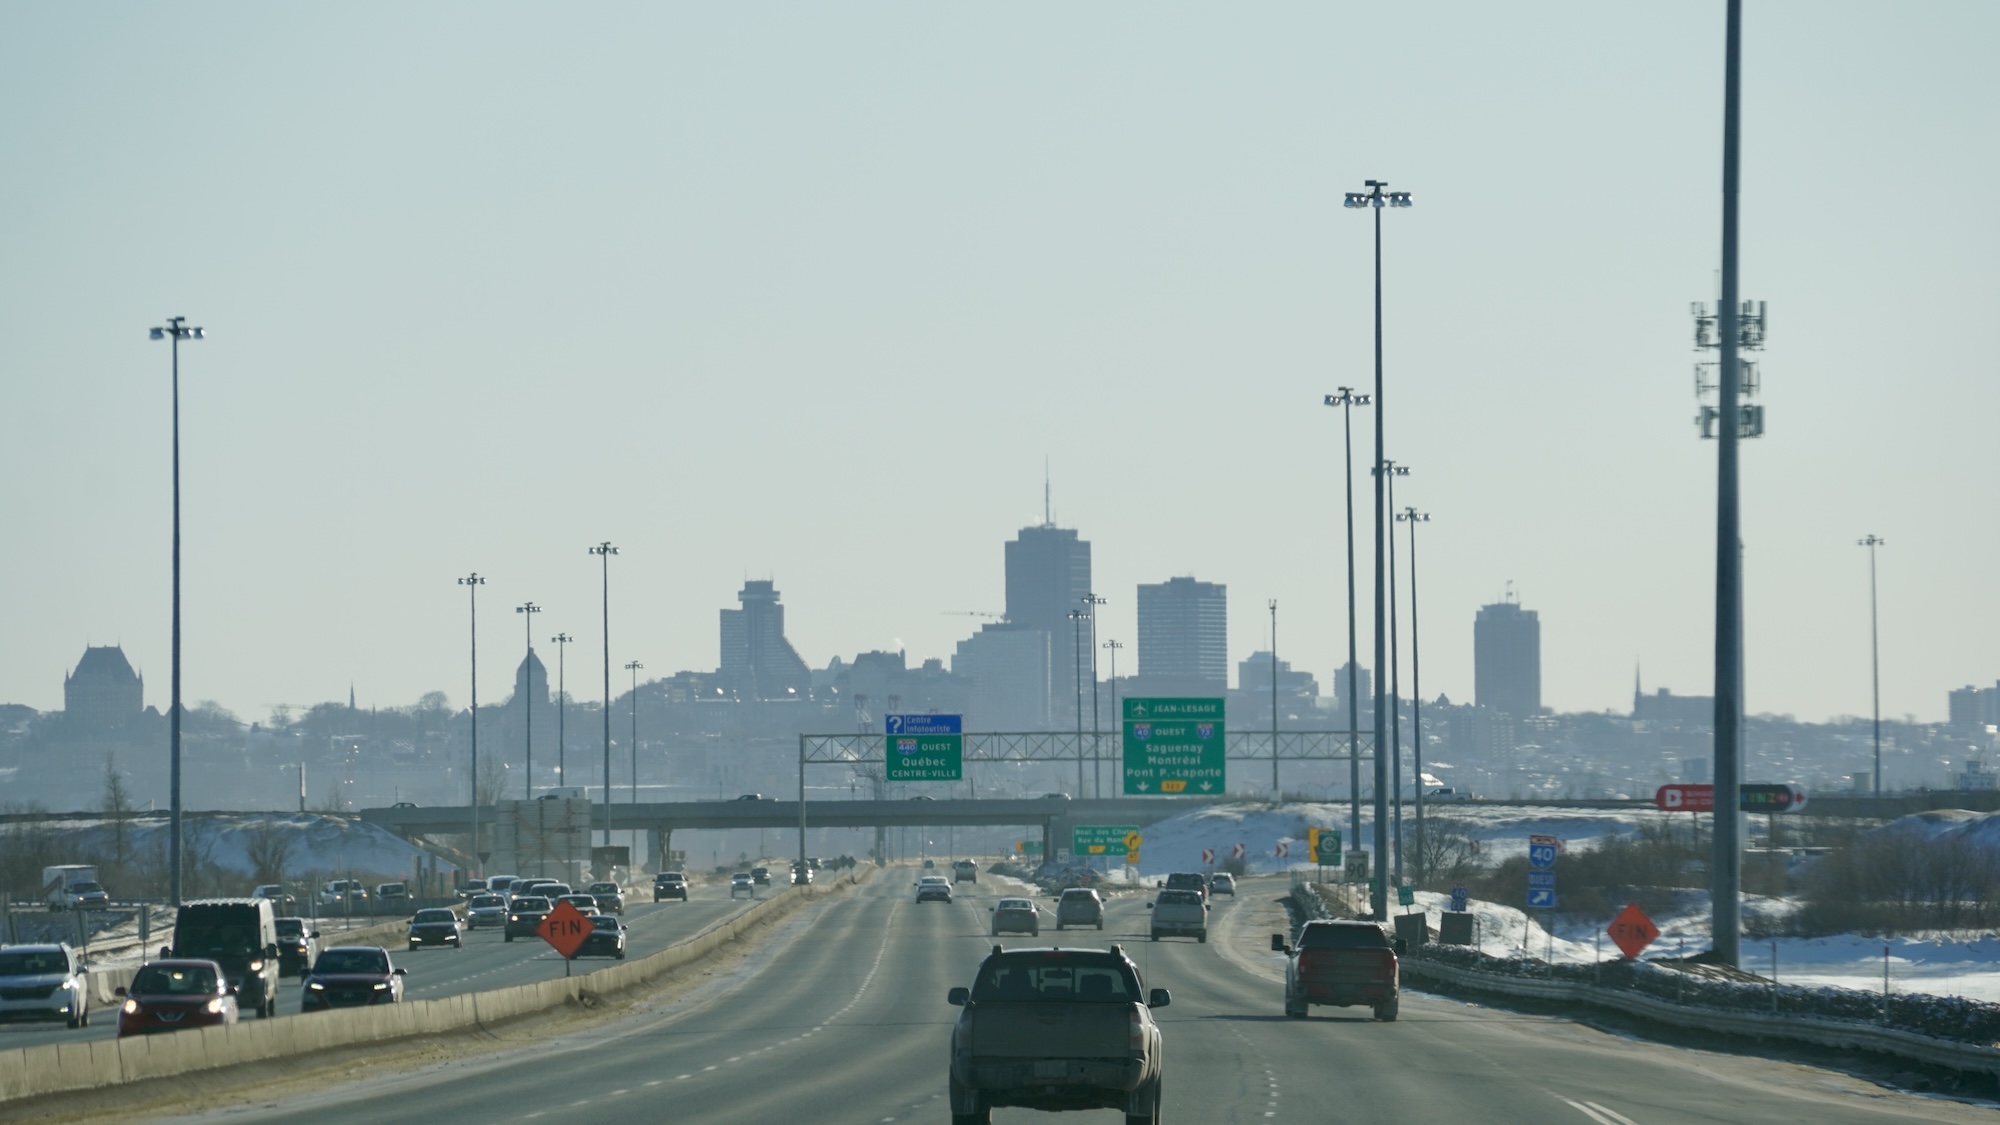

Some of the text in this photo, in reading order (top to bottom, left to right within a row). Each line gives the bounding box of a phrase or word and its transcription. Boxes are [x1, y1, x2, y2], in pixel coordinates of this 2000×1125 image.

[1153, 704, 1216, 713] JEAN-LESAGE
[907, 716, 931, 724] Centre
[907, 725, 951, 733] Infotouriste
[1155, 728, 1186, 736] OUEST
[921, 743, 951, 751] OUEST
[1145, 744, 1204, 754] Saguenay
[902, 757, 946, 767] Québec
[1148, 755, 1201, 765] Montréal
[891, 769, 957, 778] CENTRE-VILLE
[1127, 768, 1222, 779] Pont P.-Laporte
[1532, 847, 1553, 861] 40
[1347, 863, 1366, 878] 90
[1453, 889, 1467, 898] 40
[549, 919, 581, 937] FIN
[1617, 923, 1648, 939] FIN
